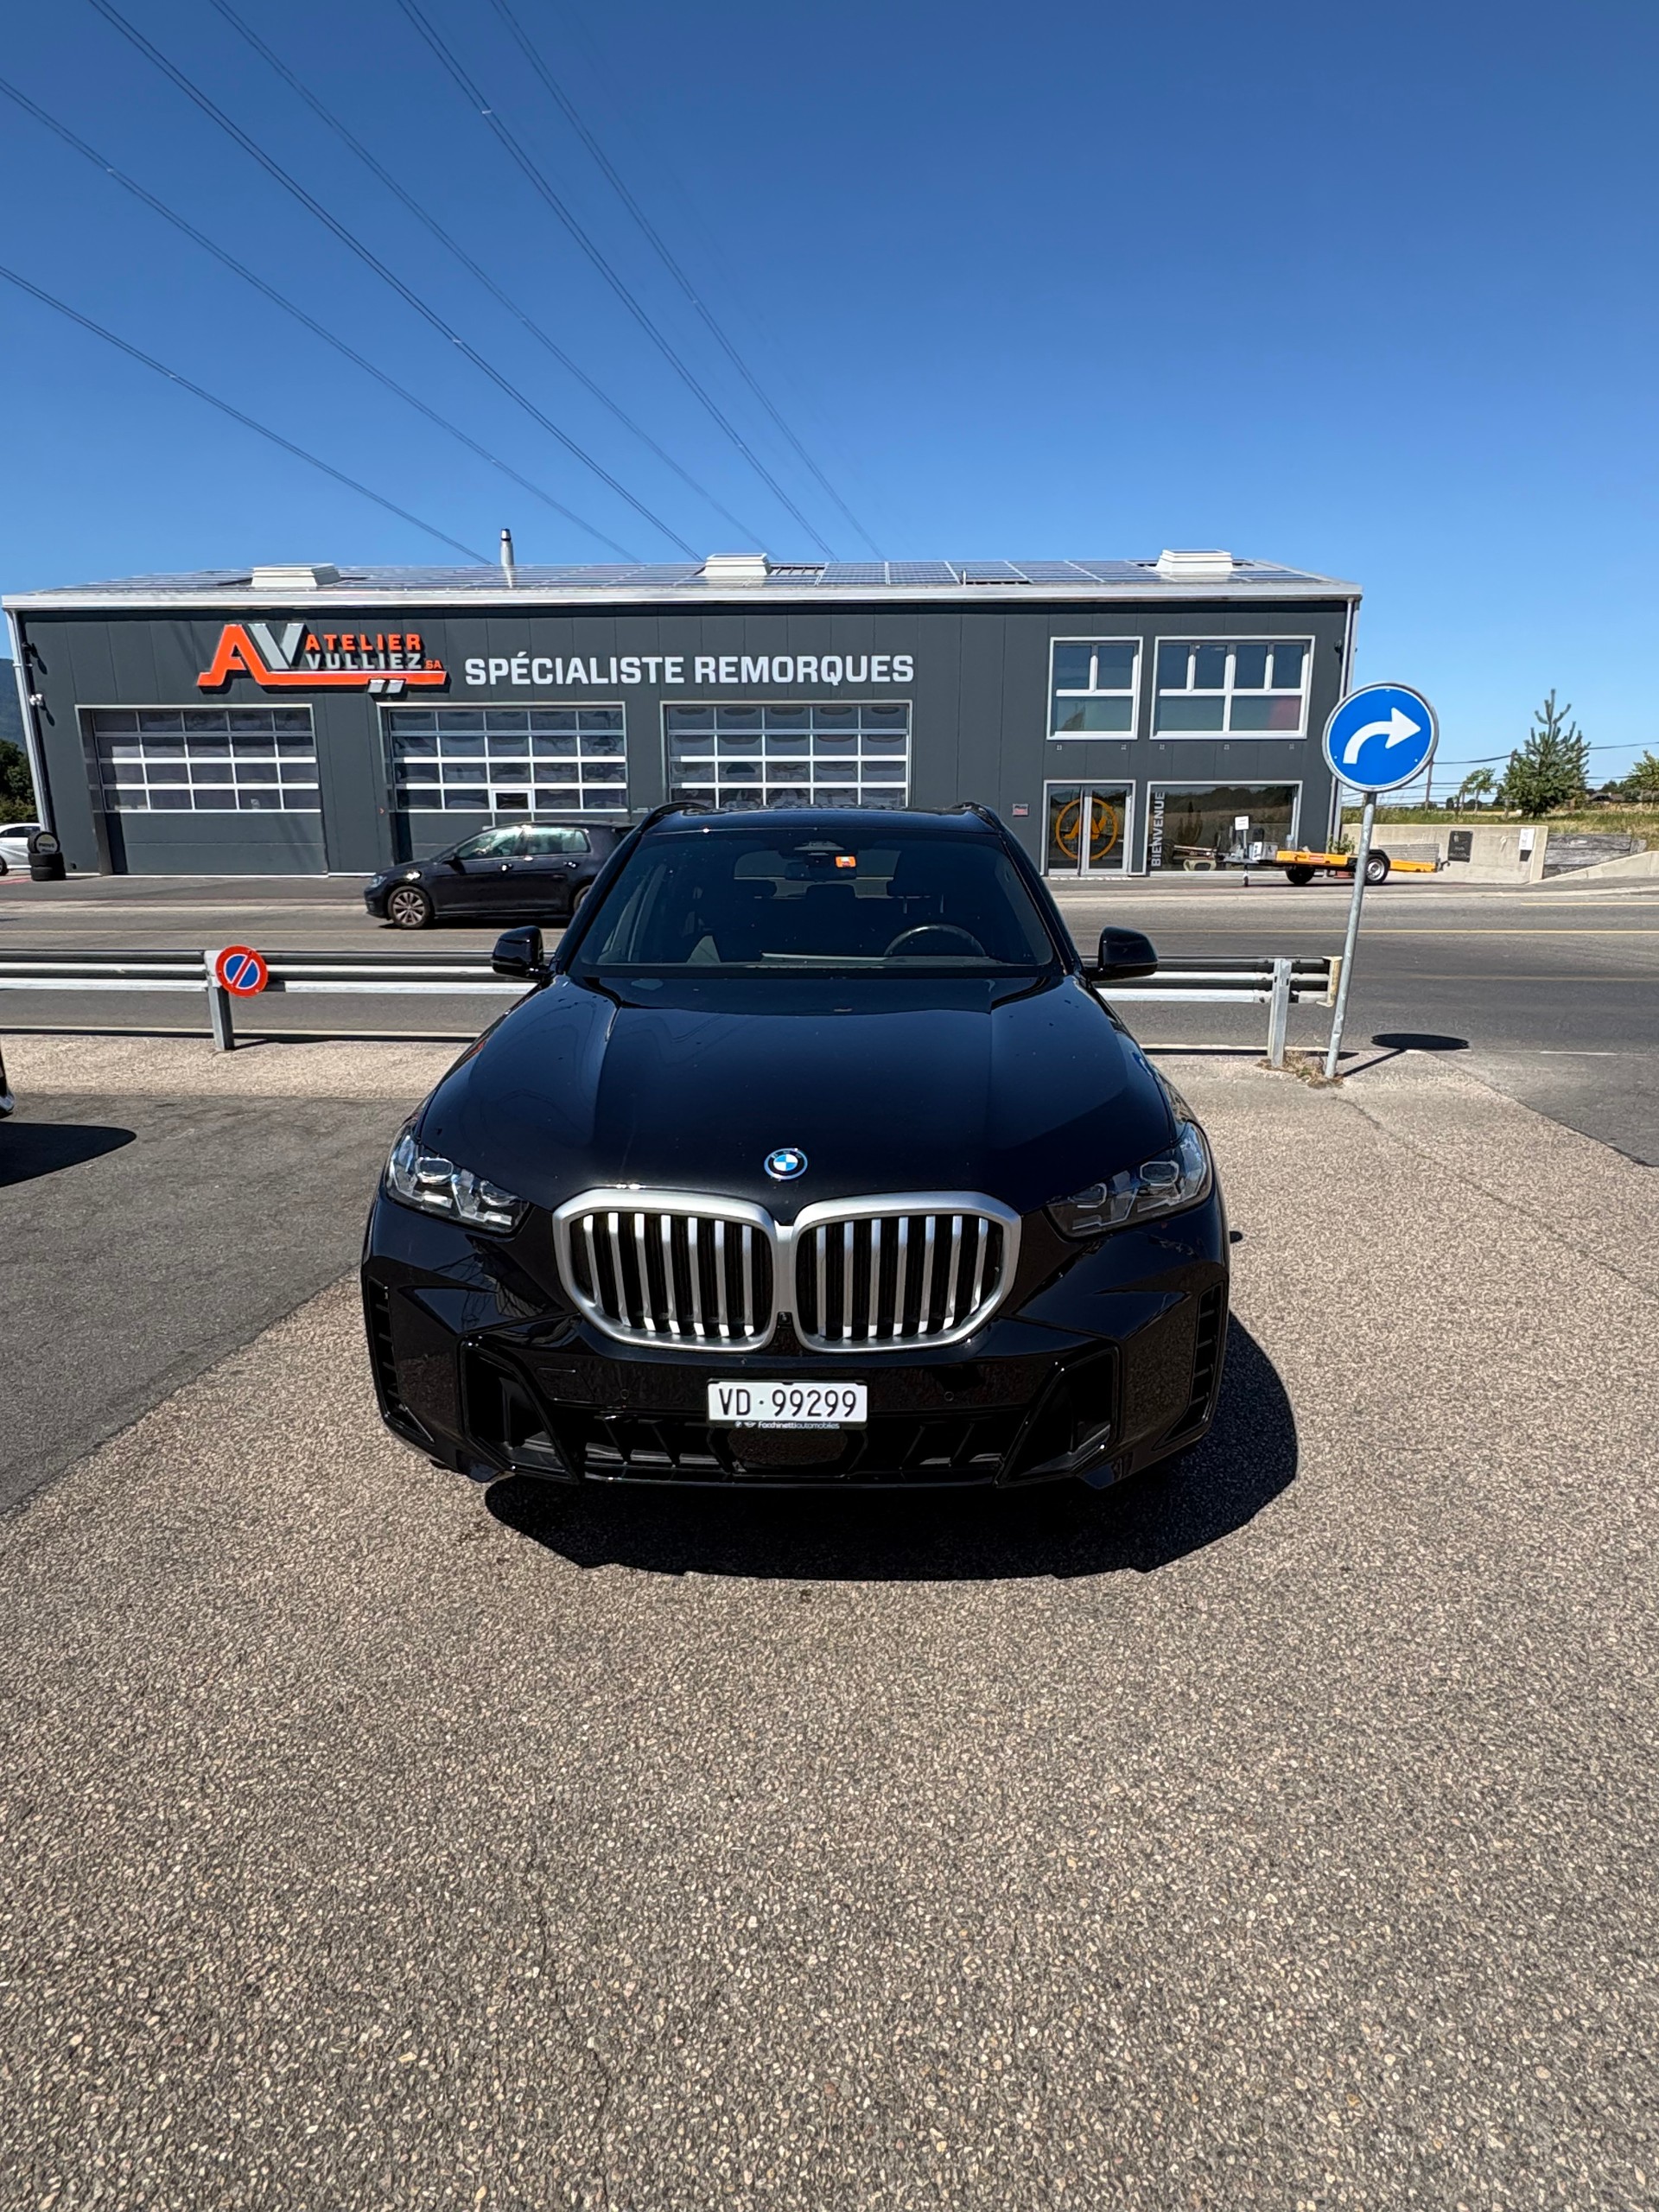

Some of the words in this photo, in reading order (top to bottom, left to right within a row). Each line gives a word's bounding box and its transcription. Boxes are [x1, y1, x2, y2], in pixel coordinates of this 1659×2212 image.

[304, 633, 422, 651] ATELIER
[305, 653, 423, 670] VULLIEZ
[424, 659, 442, 670] SA
[464, 651, 685, 685] SPÉCIALISTE
[694, 655, 914, 686] REMORQUES
[1151, 791, 1166, 867] BIENVENUE
